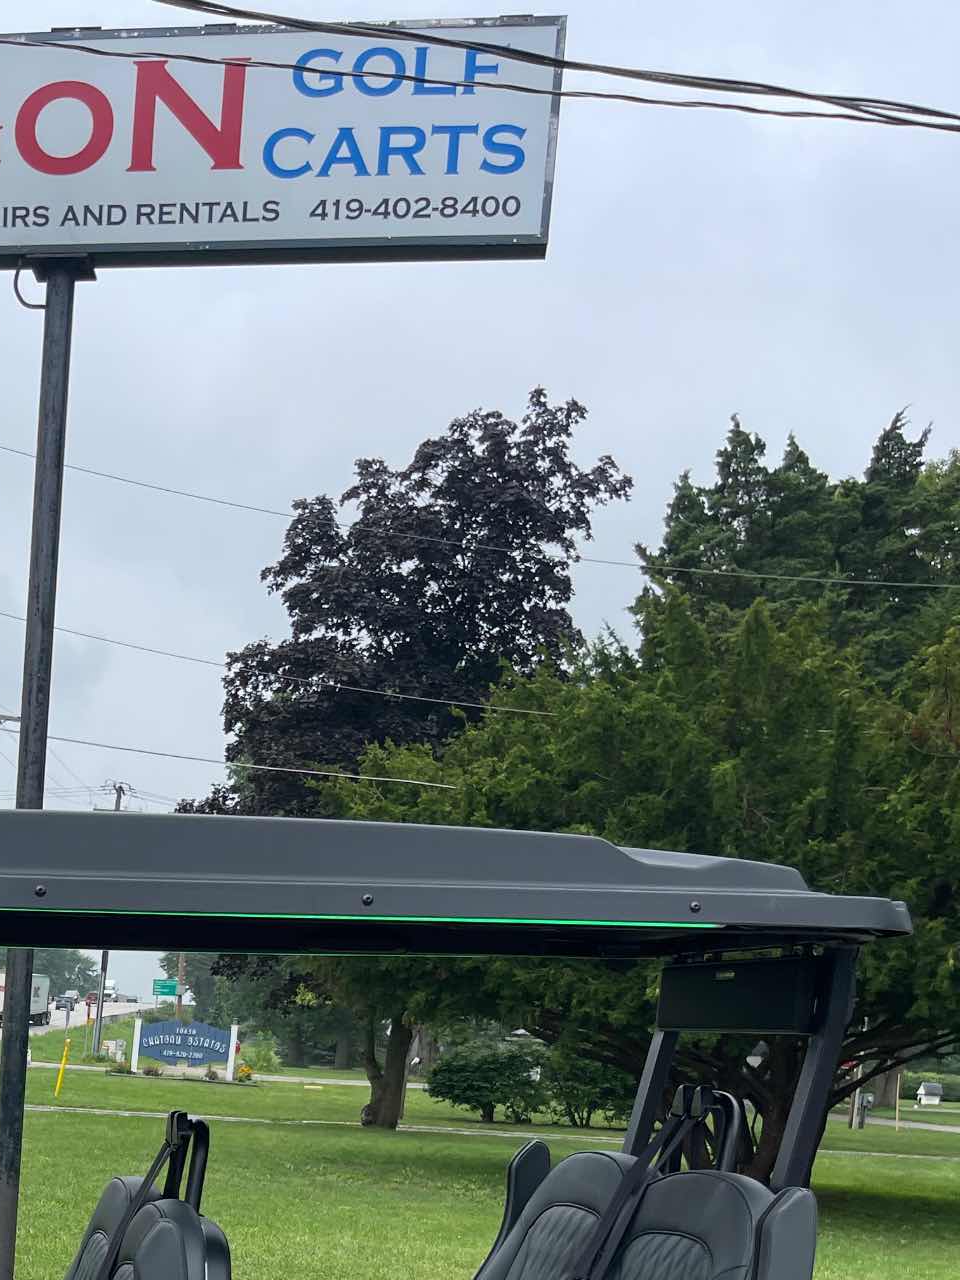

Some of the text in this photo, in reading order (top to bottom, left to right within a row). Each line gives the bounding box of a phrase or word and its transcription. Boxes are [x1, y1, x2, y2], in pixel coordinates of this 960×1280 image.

[292, 43, 511, 98] GOLF
[262, 124, 527, 179] CARTS
[60, 203, 128, 228] AND
[135, 200, 281, 226] RENTALS
[309, 195, 522, 222] 419-402-8400
